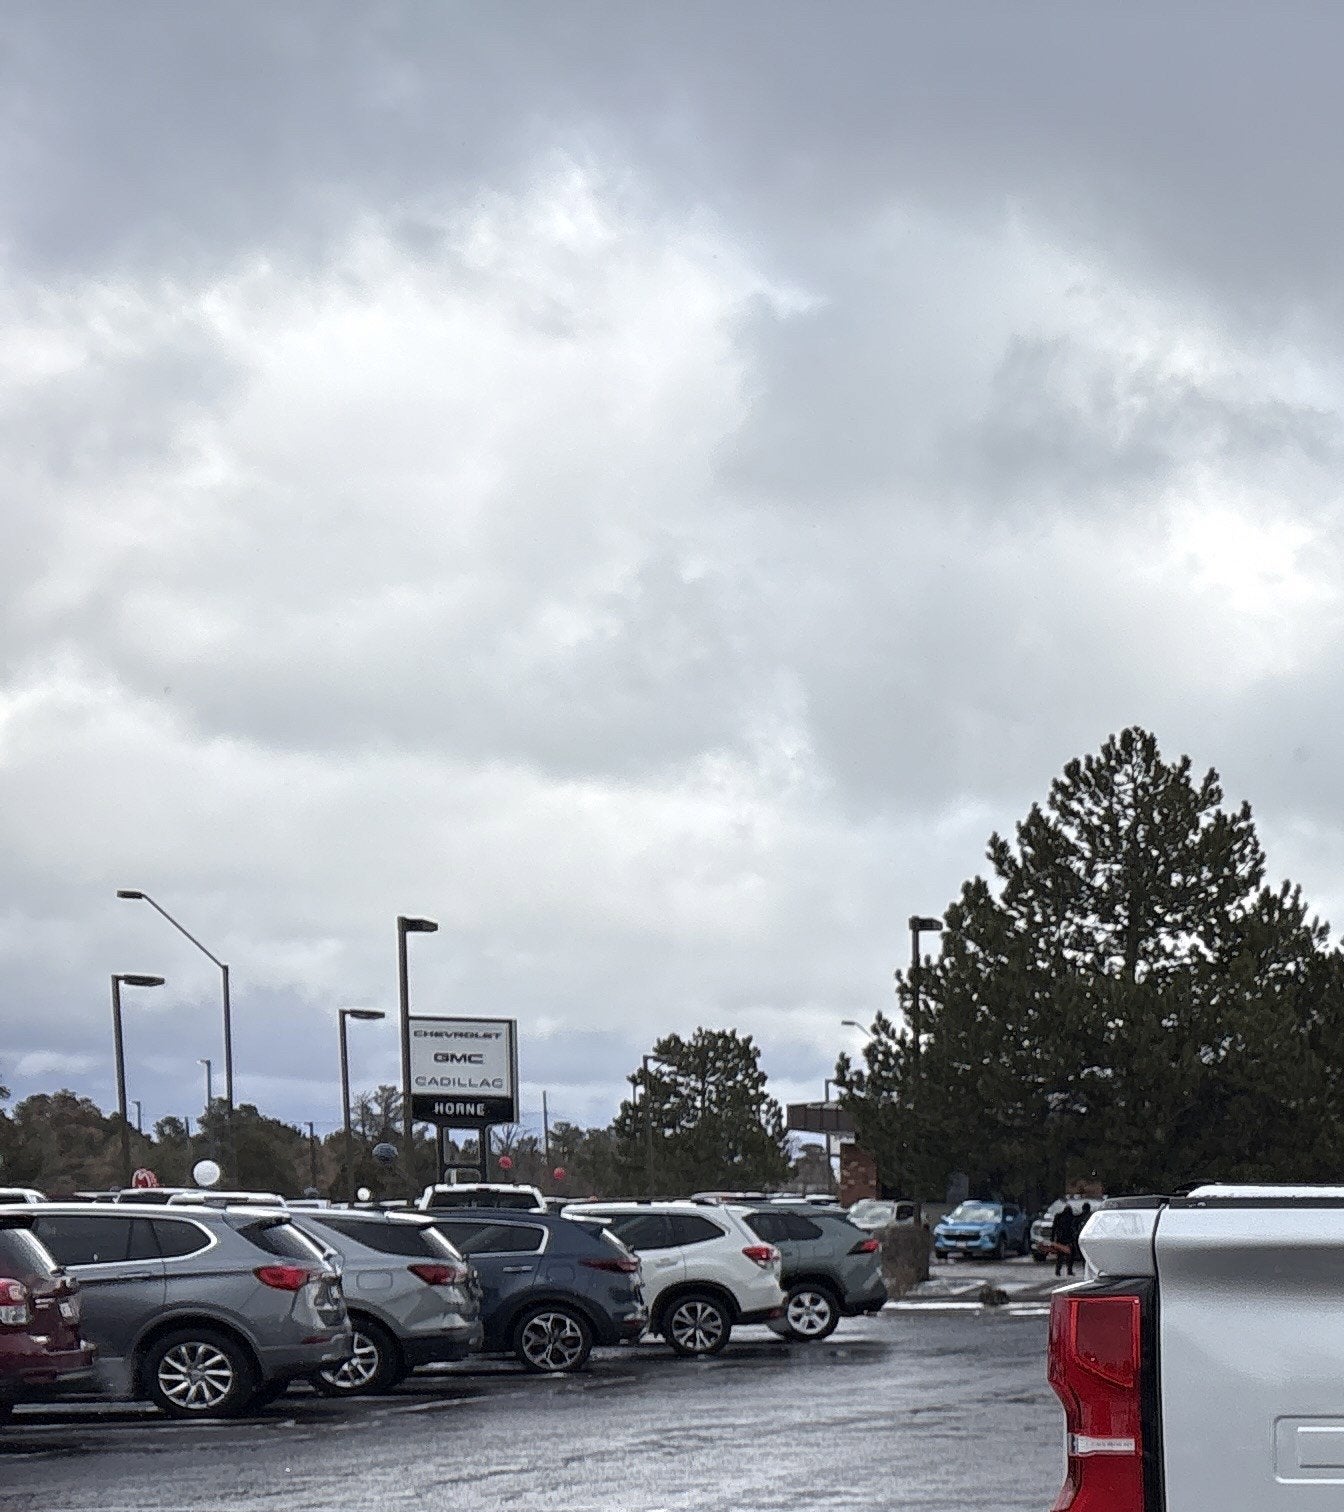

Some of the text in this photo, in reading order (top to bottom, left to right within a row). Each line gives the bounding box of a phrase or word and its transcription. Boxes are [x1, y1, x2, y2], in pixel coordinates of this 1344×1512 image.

[413, 1029, 502, 1040] CHEVROLET
[433, 1052, 484, 1065] GMC
[414, 1075, 504, 1090] CADILLAC
[434, 1101, 486, 1117] HORNE
